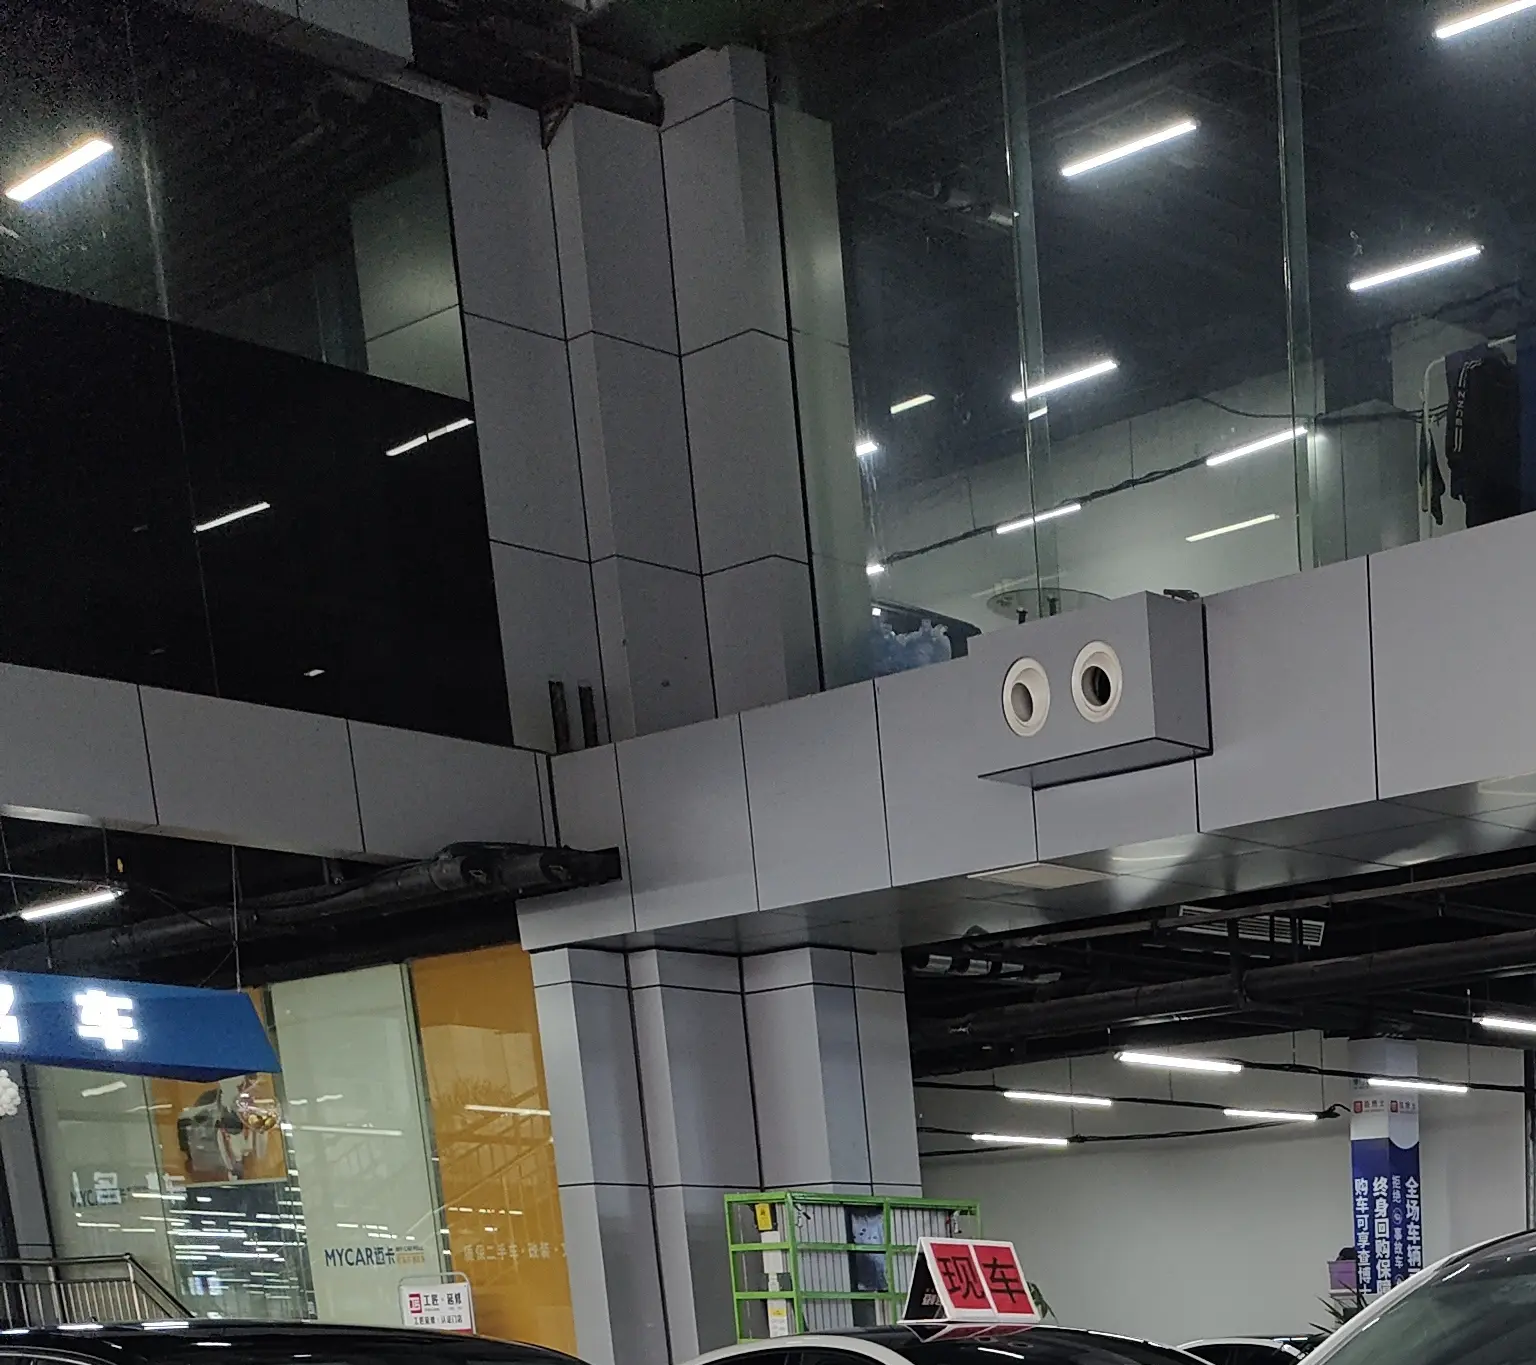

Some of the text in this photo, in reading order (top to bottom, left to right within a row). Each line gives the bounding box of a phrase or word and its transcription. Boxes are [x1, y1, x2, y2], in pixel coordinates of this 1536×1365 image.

[1354, 1177, 1372, 1295] 购车可享查博士
[936, 1256, 1027, 1303] 现车
